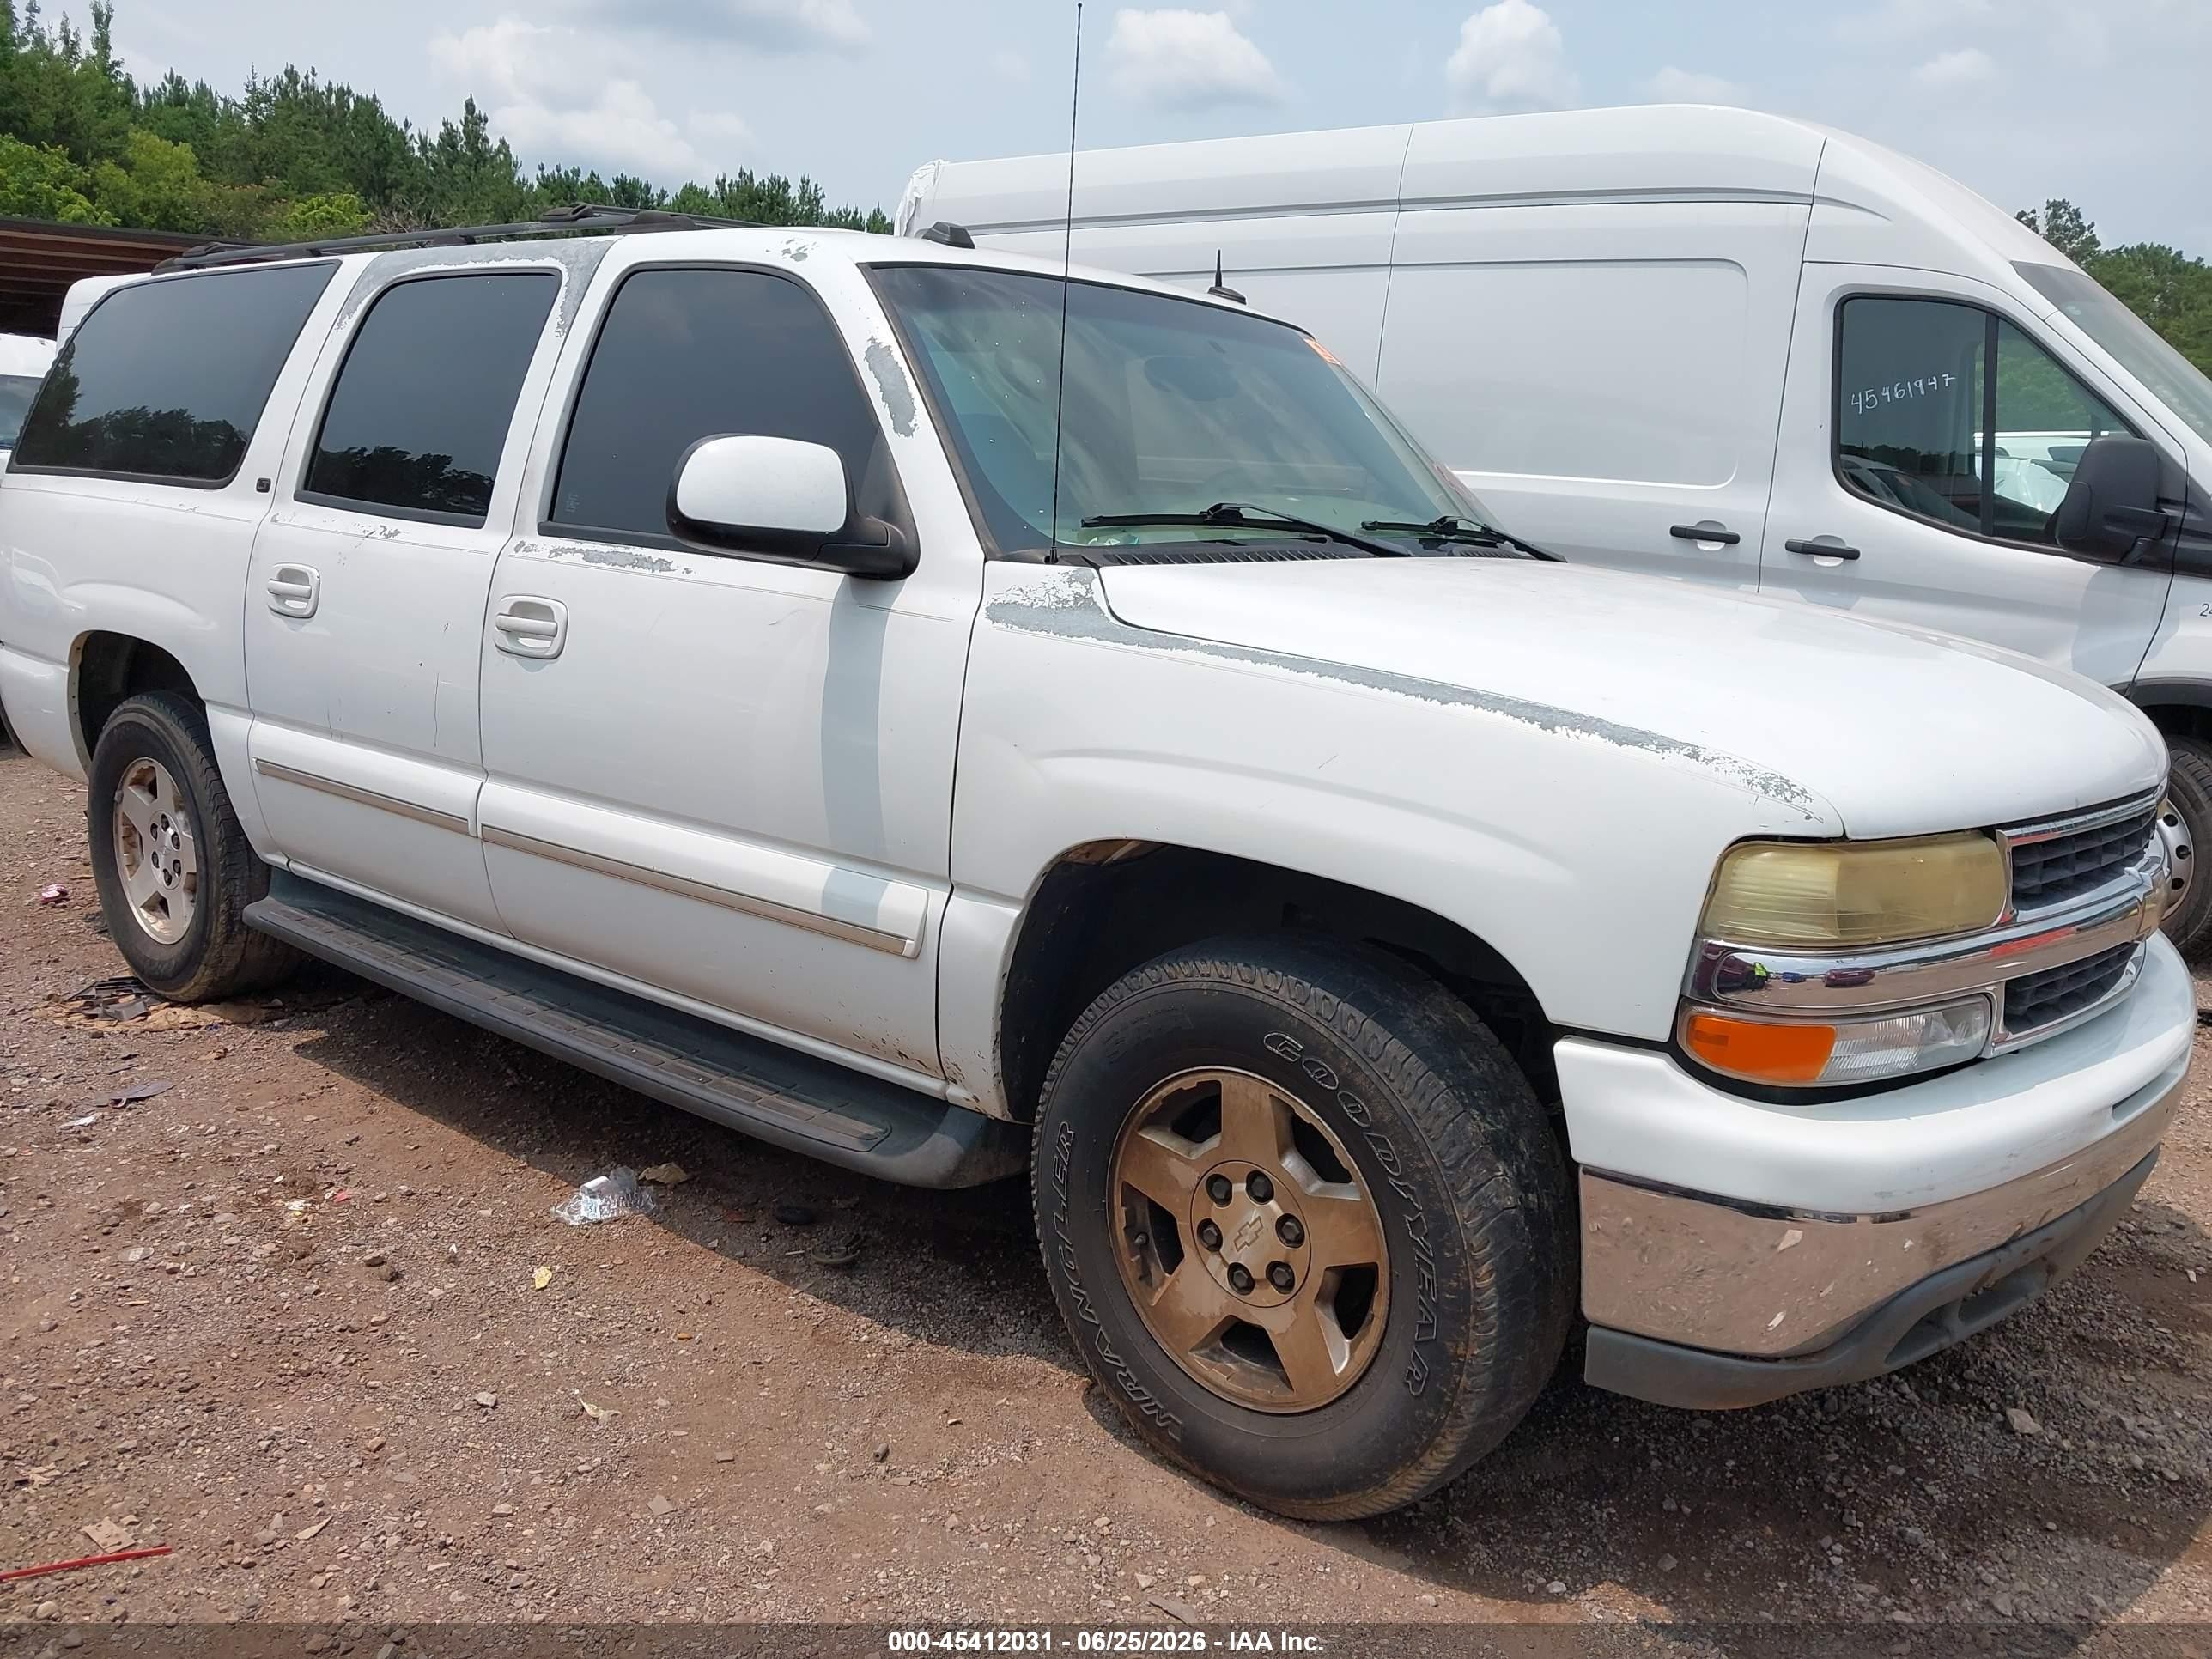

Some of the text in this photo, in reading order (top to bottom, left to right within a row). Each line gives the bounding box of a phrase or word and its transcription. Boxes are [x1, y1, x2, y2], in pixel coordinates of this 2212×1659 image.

[1850, 373, 1957, 415] 45461947
[1052, 1121, 1184, 1443] WRANGLER
[1262, 1031, 1437, 1397] GOODYEAR
